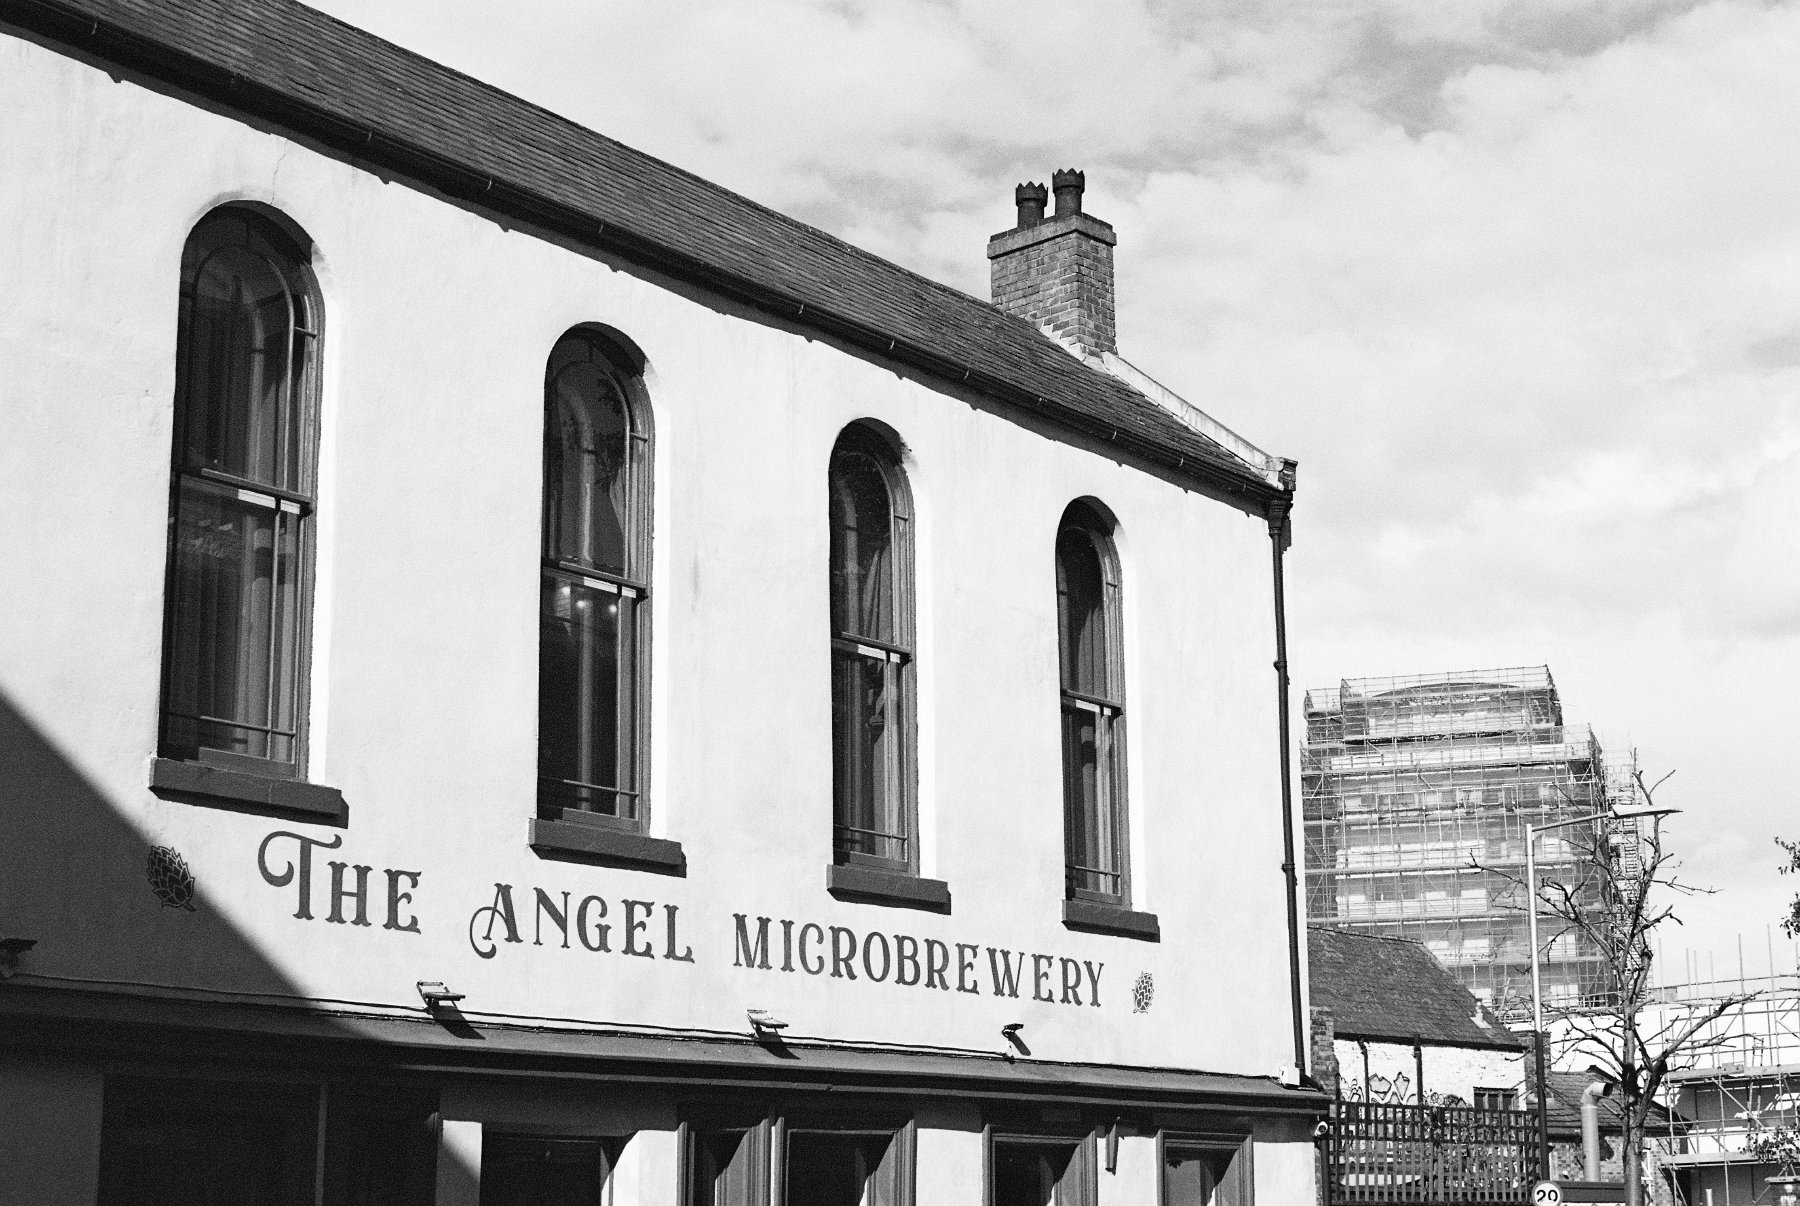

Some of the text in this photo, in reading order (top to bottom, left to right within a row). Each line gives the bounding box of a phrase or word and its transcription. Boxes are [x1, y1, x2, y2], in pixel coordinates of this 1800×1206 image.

[257, 830, 1105, 1008] THE ANGEL MICROBREWERY
[1536, 1189, 1559, 1203] 20
